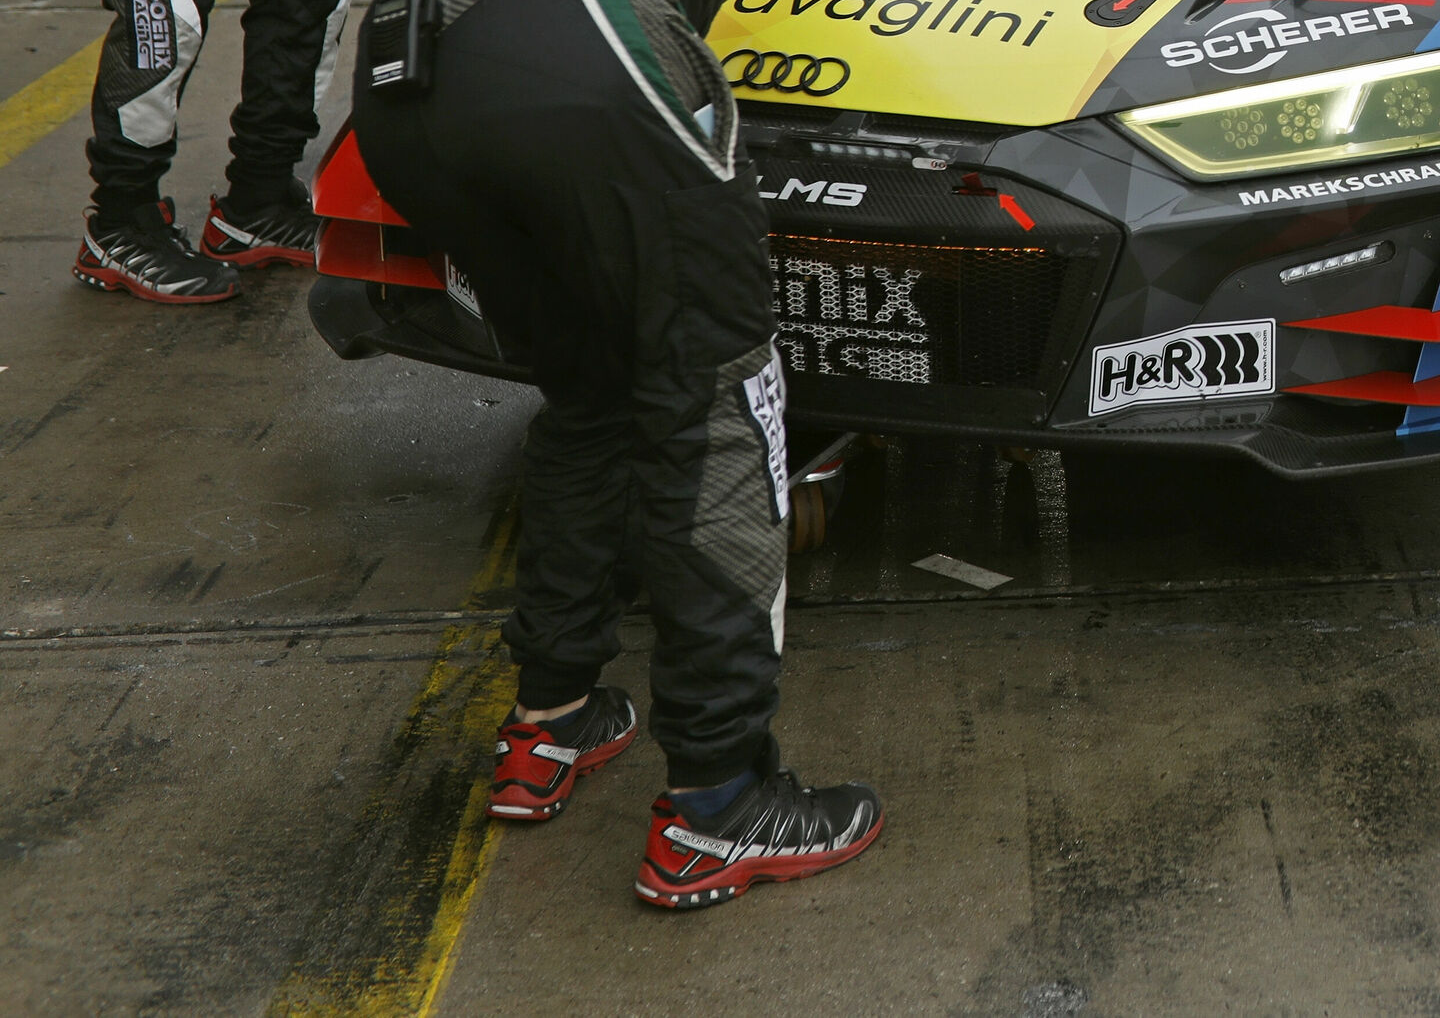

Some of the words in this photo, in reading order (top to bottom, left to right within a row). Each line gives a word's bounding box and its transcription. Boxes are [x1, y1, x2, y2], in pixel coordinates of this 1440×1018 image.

[1161, 3, 1414, 70] SCHERER
[1101, 341, 1195, 398] H&R
[672, 829, 725, 851] salomon
